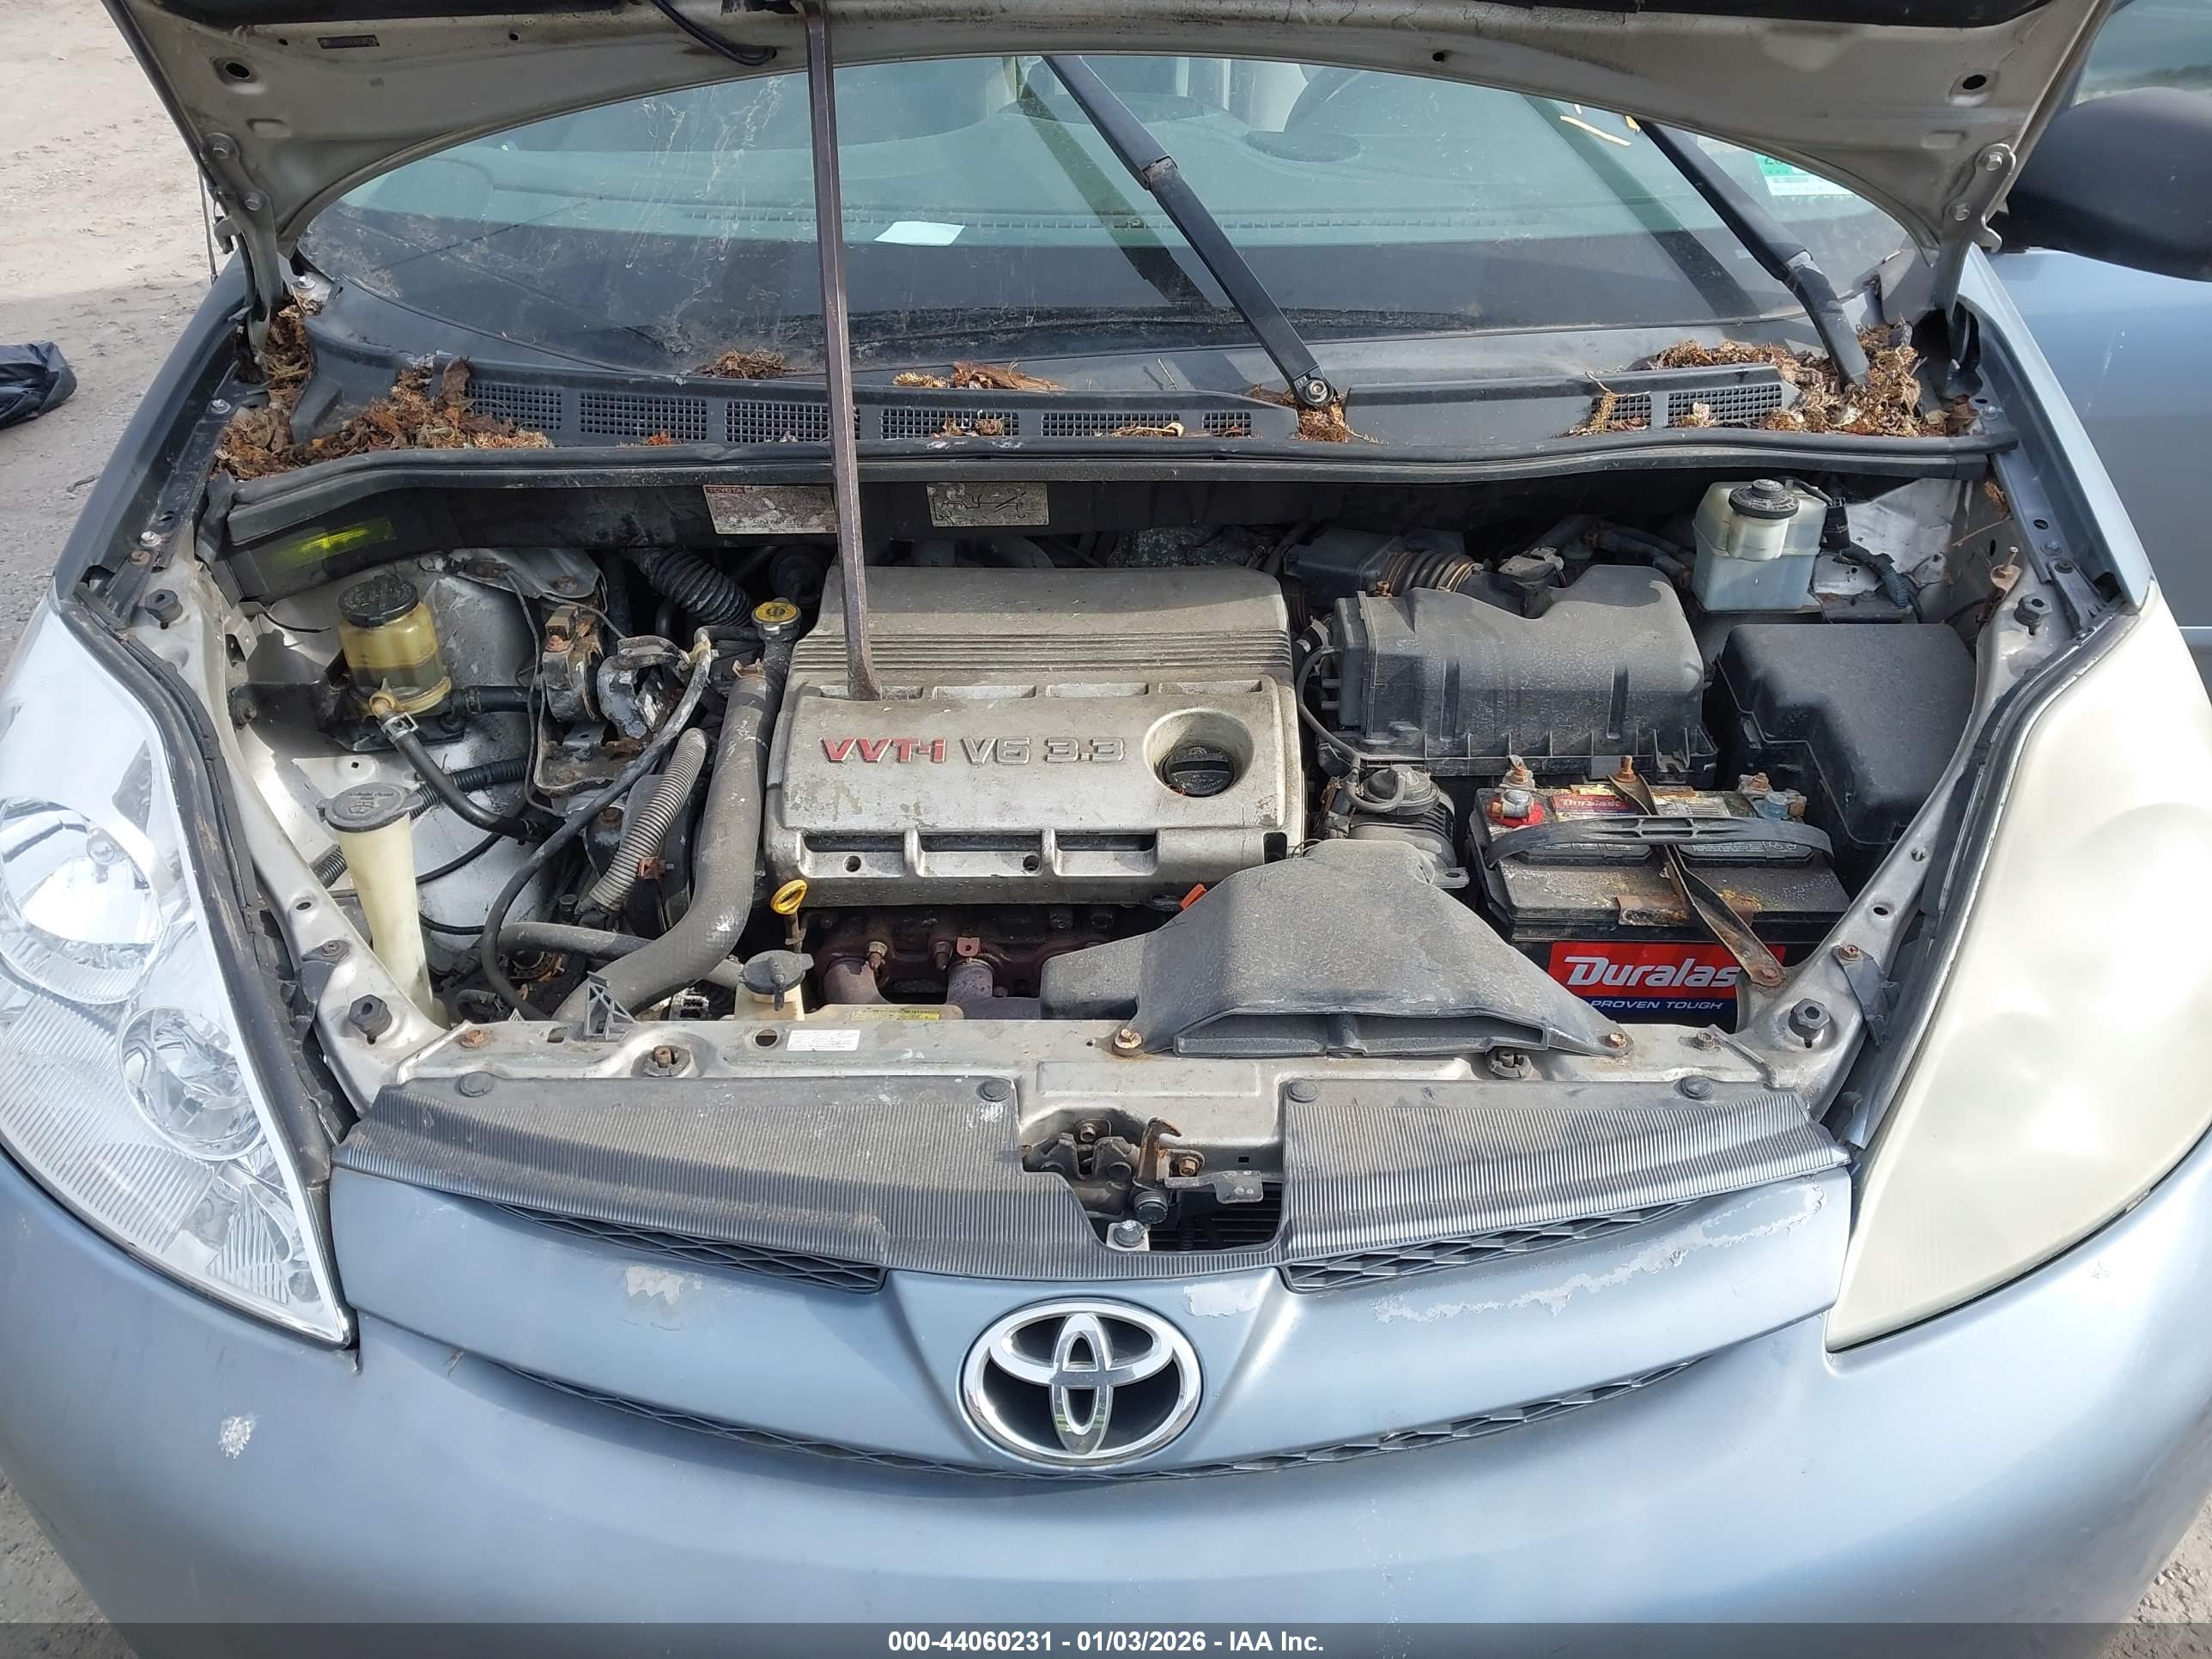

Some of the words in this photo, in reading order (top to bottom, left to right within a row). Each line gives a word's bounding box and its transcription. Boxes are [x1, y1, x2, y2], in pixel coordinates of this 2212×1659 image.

[962, 736, 1030, 765] V6
[1044, 737, 1127, 764] 3.3
[1564, 956, 1742, 988] Duralas
[1590, 1000, 1661, 1010] PROVEN
[1666, 1000, 1723, 1011] TOUGH
